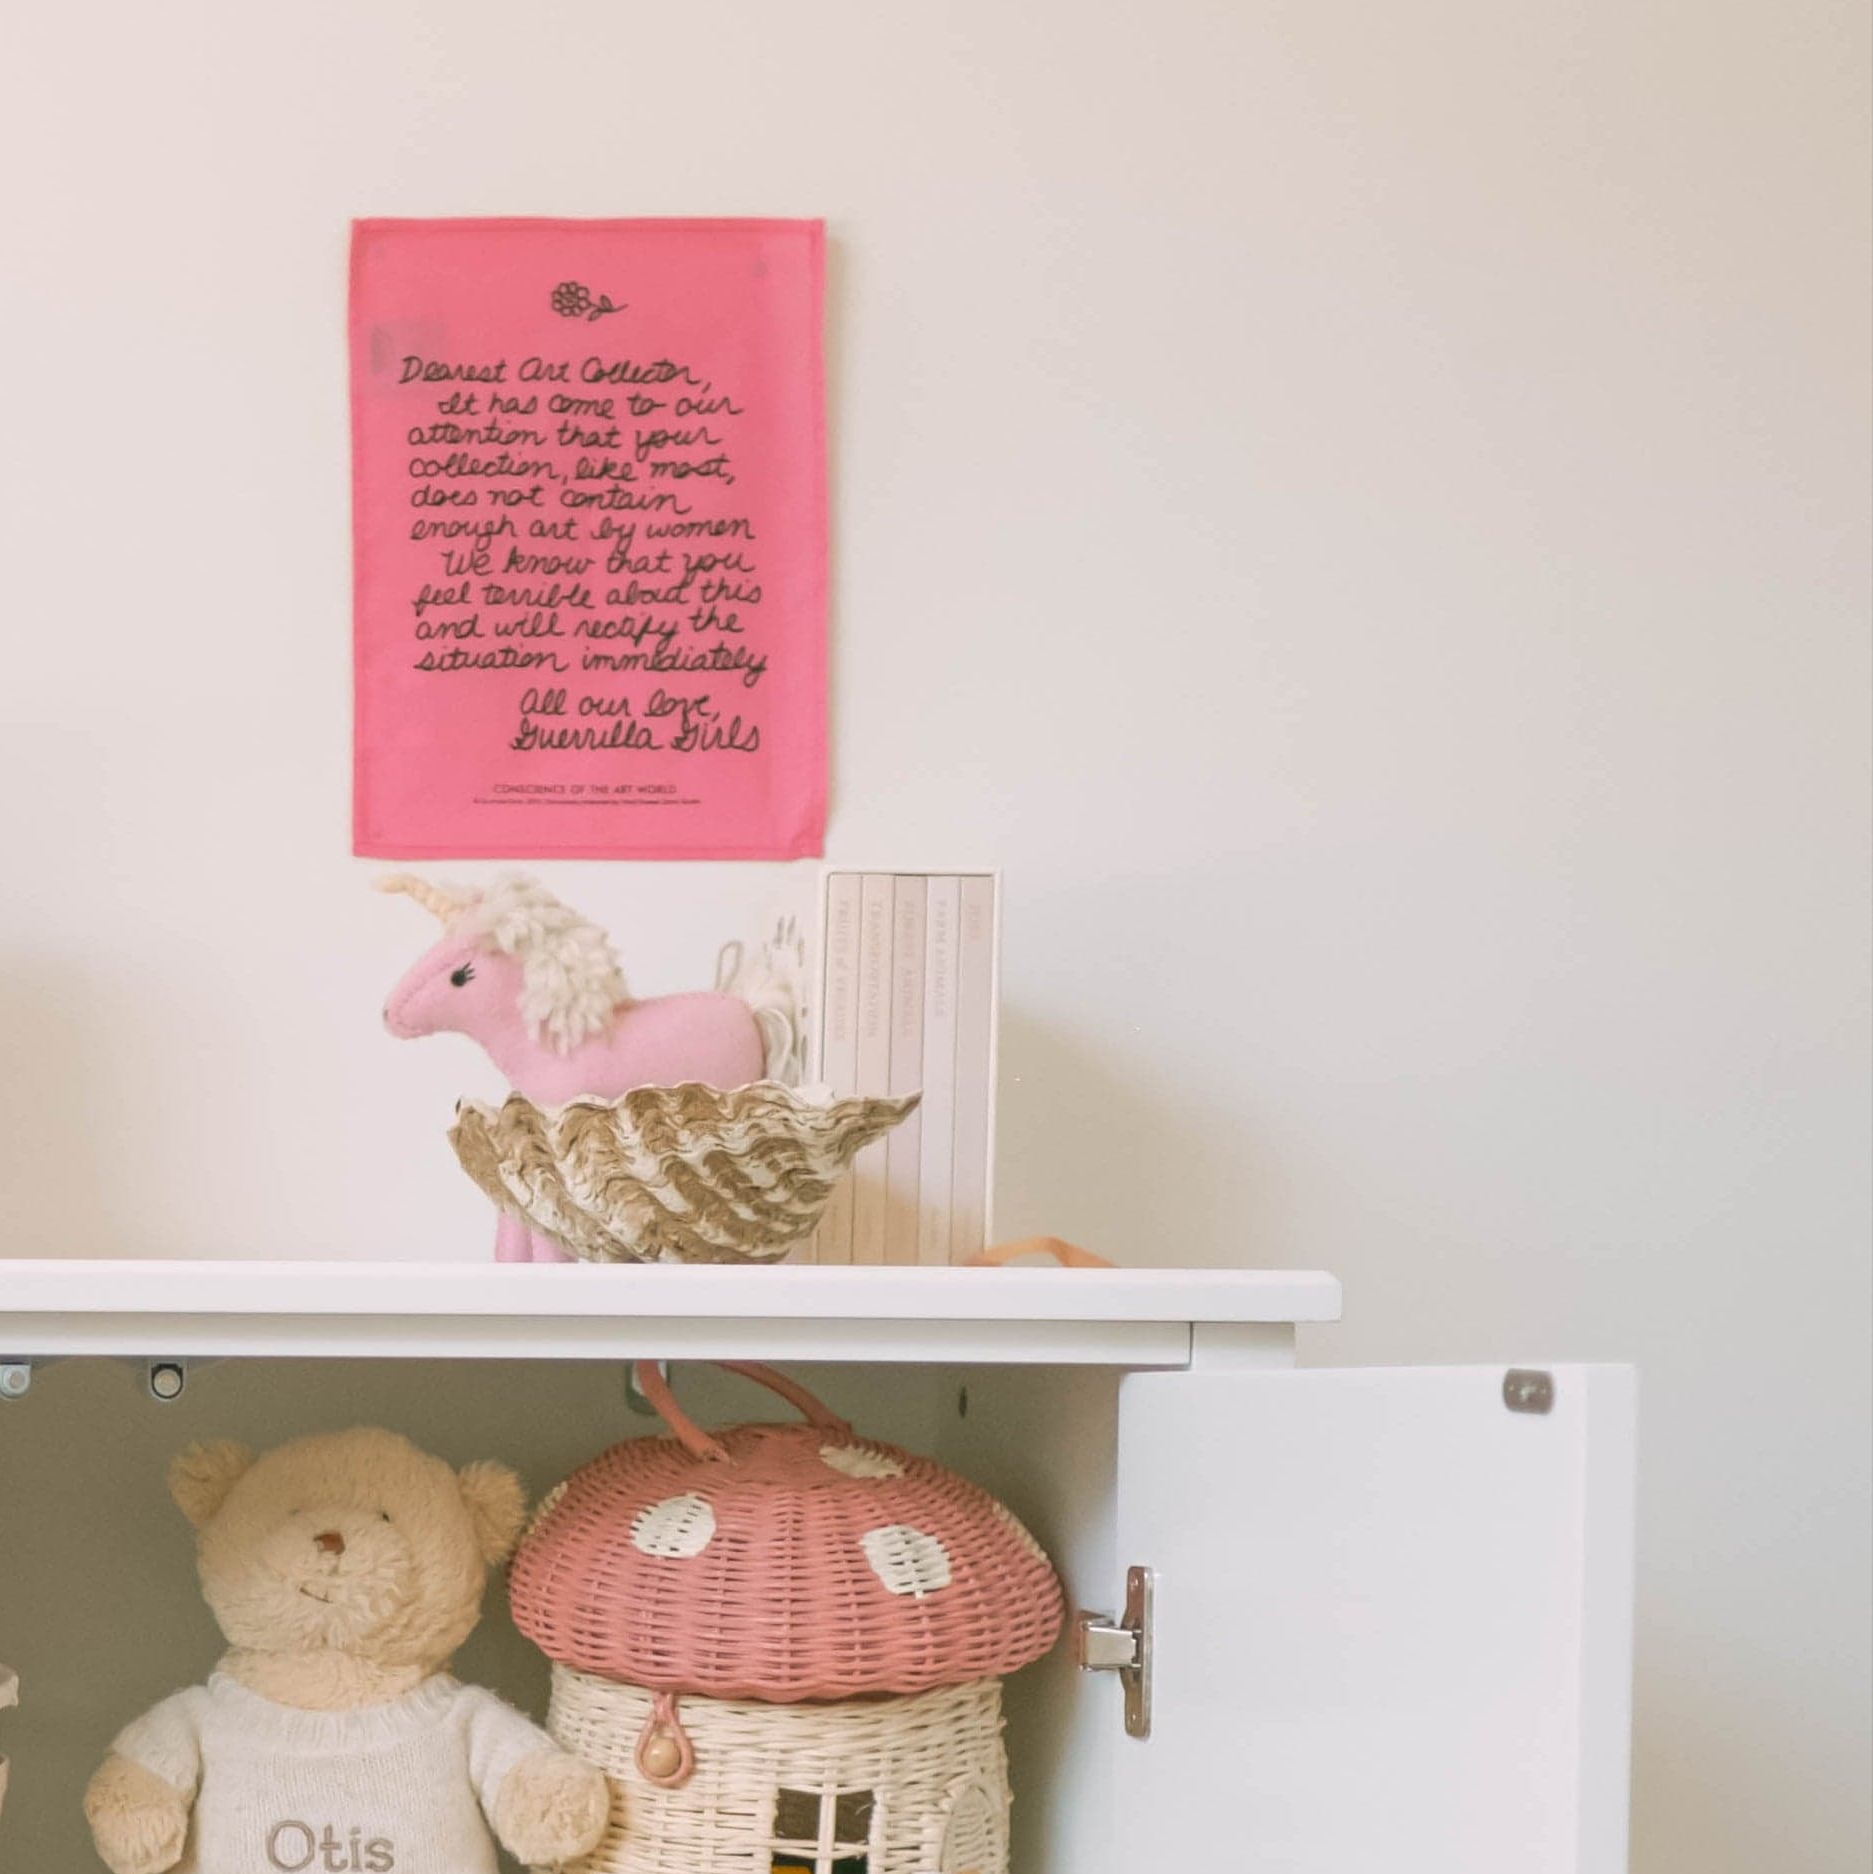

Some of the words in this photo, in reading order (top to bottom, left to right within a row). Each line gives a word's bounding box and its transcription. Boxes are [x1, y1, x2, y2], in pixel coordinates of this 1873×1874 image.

[398, 355, 507, 385] Dearest
[519, 357, 570, 383] Art
[580, 358, 711, 394] Collector,
[438, 392, 478, 416] It
[489, 394, 538, 415] has
[549, 394, 615, 420] come
[627, 393, 667, 417] to
[675, 396, 743, 418] our
[407, 419, 547, 447] attention
[557, 419, 621, 449] that
[635, 426, 724, 463] your
[409, 452, 568, 486] collection,
[574, 456, 637, 483] like
[650, 456, 735, 486] most,
[411, 485, 478, 508] does
[488, 485, 543, 507] not
[559, 484, 691, 516] contain
[410, 514, 519, 553] enough
[529, 518, 577, 541] art
[590, 516, 636, 551] by
[646, 518, 756, 540] women
[442, 550, 492, 577] We
[503, 547, 595, 576] know
[606, 548, 672, 574] that
[682, 553, 755, 589] you
[412, 584, 472, 617] feel
[482, 583, 595, 609] terrible
[606, 578, 690, 606] about
[700, 577, 762, 605] this
[415, 613, 484, 641] and
[494, 611, 565, 638] will
[573, 615, 679, 649] rectify
[688, 606, 745, 634] the
[414, 645, 569, 673] situation
[581, 640, 767, 688] immediately
[519, 687, 567, 717] All
[578, 696, 630, 717] our
[643, 688, 720, 724] love,
[510, 718, 663, 752] Guerrilla
[670, 718, 760, 752] Girls
[589, 784, 610, 794] THE
[266, 1819, 395, 1873] Otis
